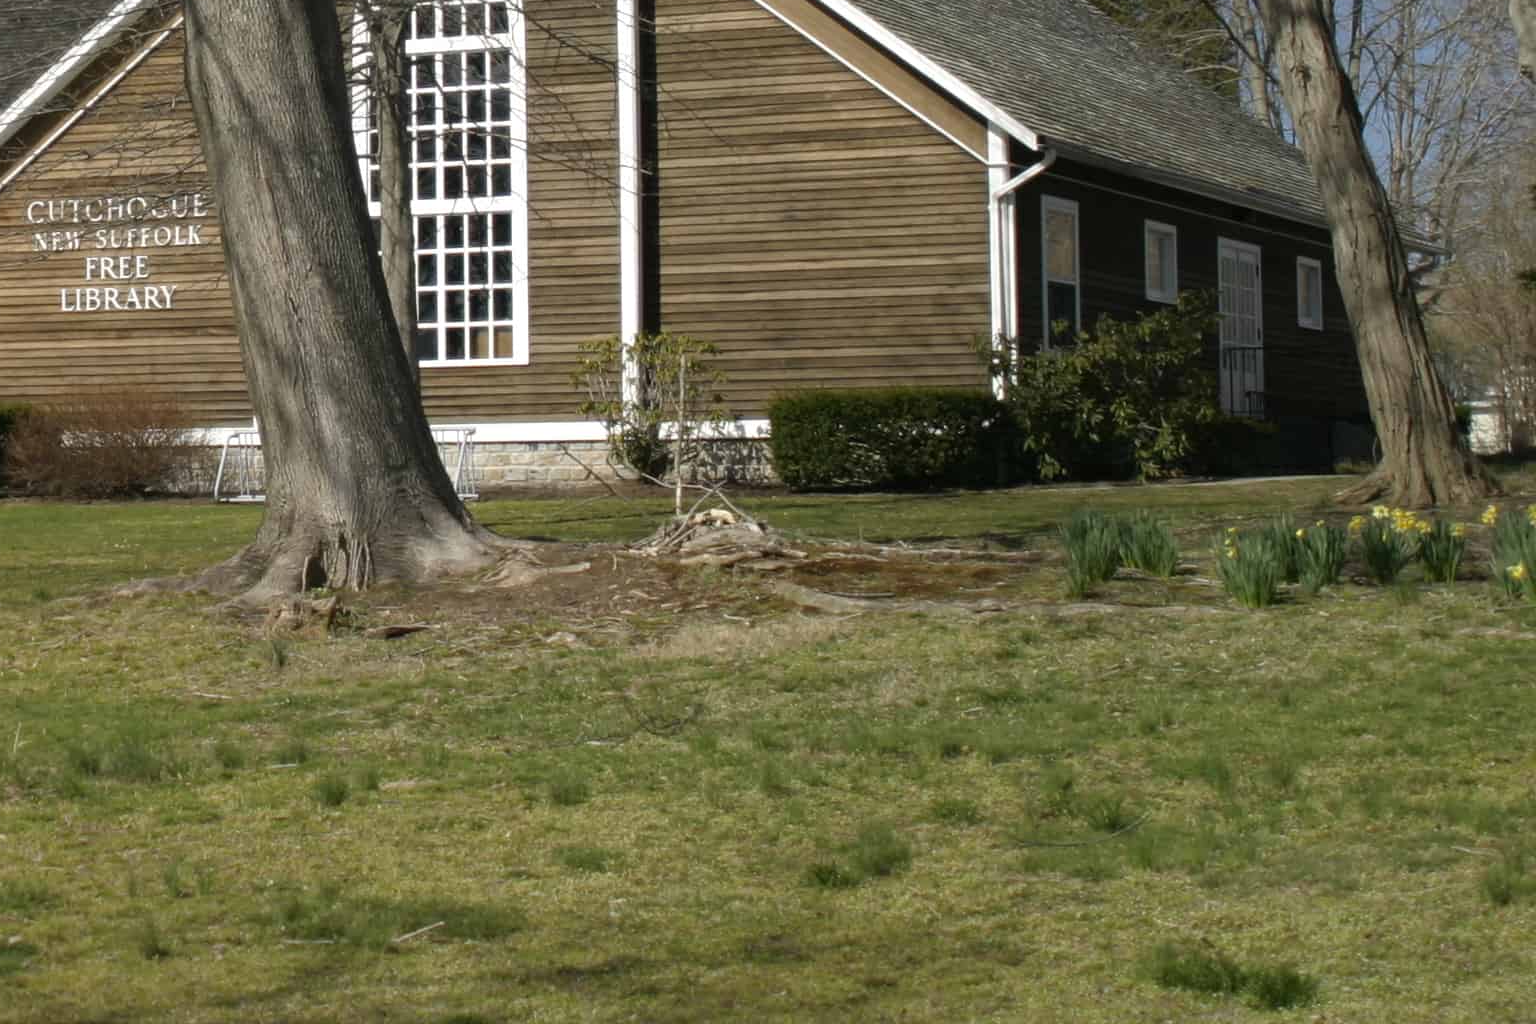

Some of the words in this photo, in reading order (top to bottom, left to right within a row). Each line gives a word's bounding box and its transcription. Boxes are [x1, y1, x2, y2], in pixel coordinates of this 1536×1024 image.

[32, 232, 81, 251] NEW
[96, 225, 202, 248] SUFFOLK
[85, 256, 149, 281] FREE
[61, 285, 177, 312] LIBRARY
